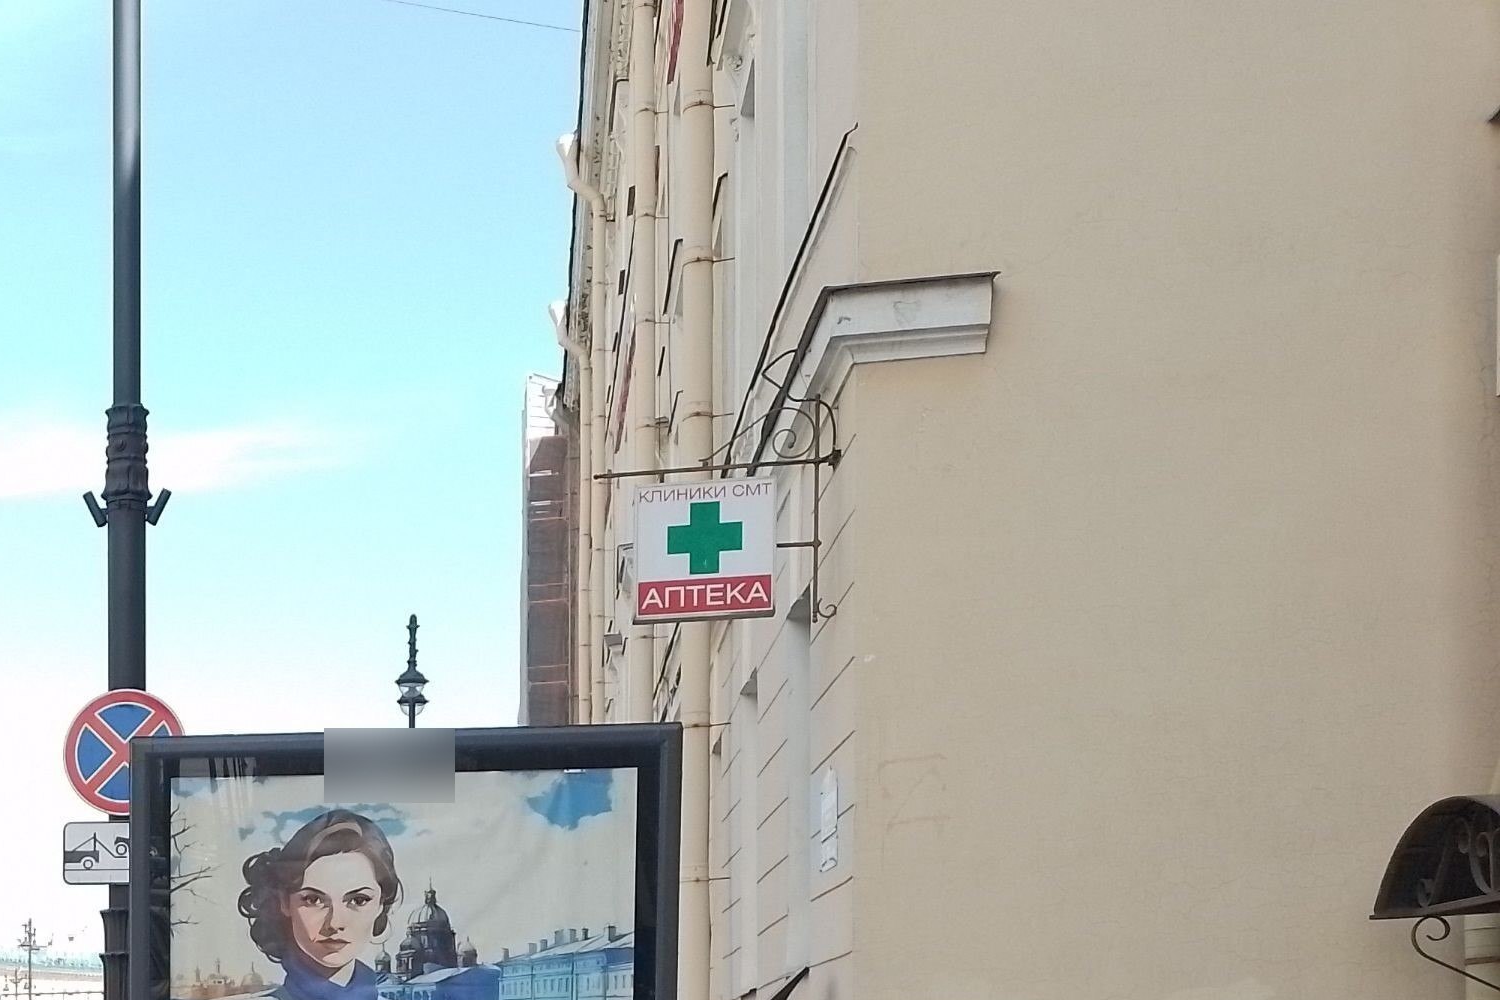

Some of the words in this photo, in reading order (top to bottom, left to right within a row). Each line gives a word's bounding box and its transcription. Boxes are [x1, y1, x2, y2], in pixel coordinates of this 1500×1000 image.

[639, 485, 727, 503] КЛИНИКИ
[732, 483, 772, 498] СМТ
[641, 581, 769, 610] АПТЕКА
